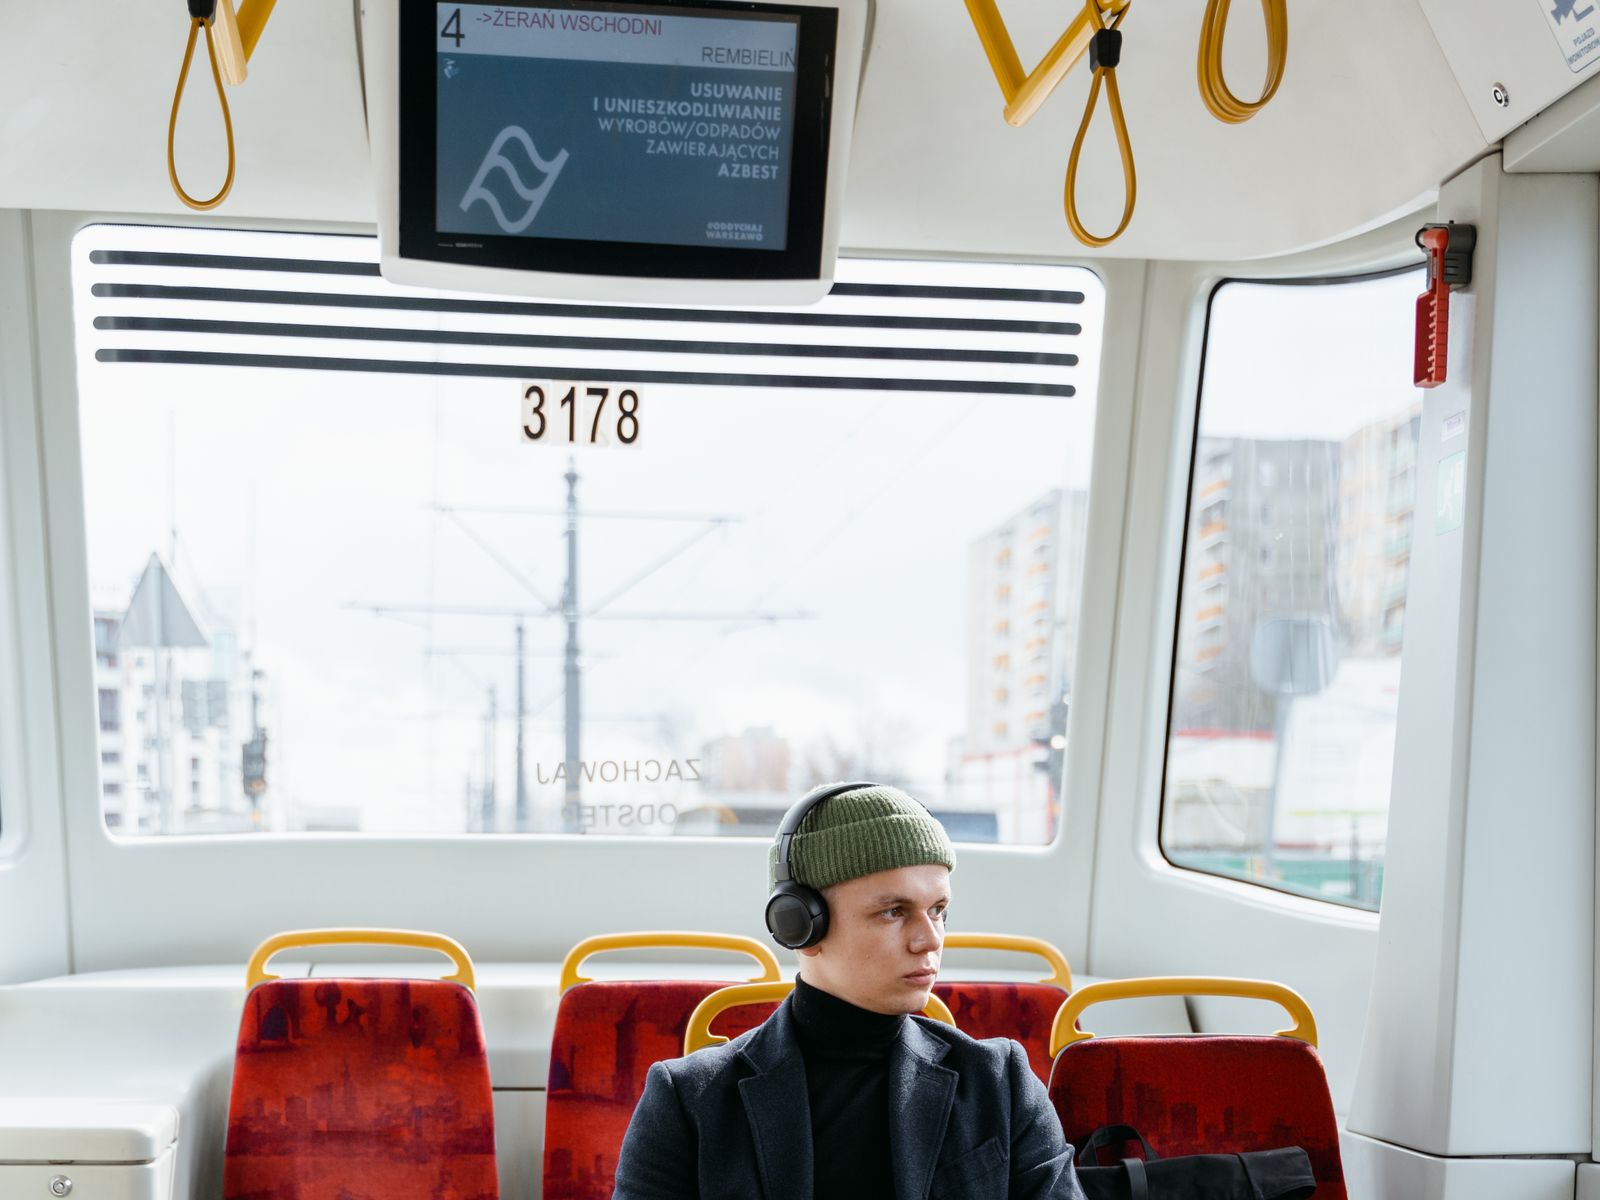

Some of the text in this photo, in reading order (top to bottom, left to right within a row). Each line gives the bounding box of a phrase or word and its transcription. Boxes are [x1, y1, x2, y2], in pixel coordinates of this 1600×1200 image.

[440, 8, 466, 47] 4
[560, 14, 662, 36] WSCHODNI
[690, 82, 783, 101] USUWANIE
[593, 97, 782, 121] I UNIESZKODLIWIANIE
[598, 117, 781, 140] WYROBÓW/ODPADÓW
[645, 139, 780, 161] ZAWIERAJĄCYCH
[717, 163, 779, 179] AZBEST
[523, 385, 639, 444] 3178
